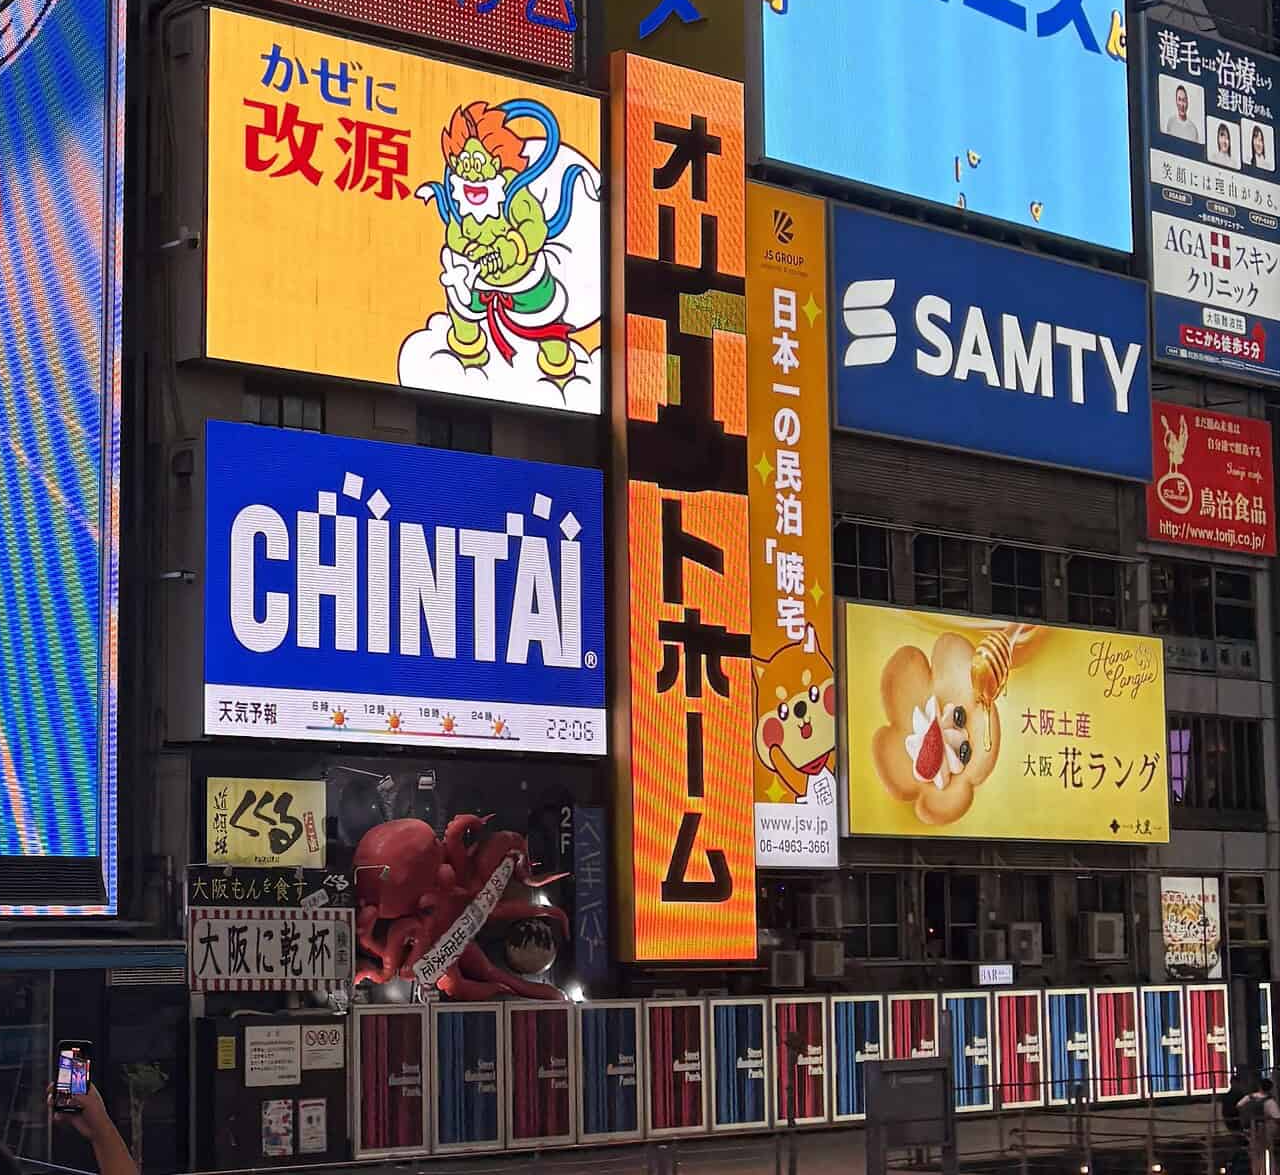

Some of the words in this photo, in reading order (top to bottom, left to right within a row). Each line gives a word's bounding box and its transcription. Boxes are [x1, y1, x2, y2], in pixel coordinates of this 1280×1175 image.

[259, 42, 399, 116] かぜに
[1157, 29, 1273, 95] 薄毛には治療という
[242, 96, 417, 203] 改源
[1162, 161, 1278, 211] 笑顔には理由がある。
[764, 249, 774, 261] JS
[775, 251, 805, 266] GROUP
[1164, 225, 1208, 260] AGA
[1234, 245, 1279, 276] スキン
[1188, 267, 1259, 308] クリニック
[914, 293, 1143, 415] SAMTY
[1185, 328, 1261, 360] ここから徒歩5分
[230, 471, 583, 669] CHINTAI
[218, 699, 278, 726] 天気予報
[1021, 707, 1092, 738] 大阪土産
[1023, 754, 1053, 777] 大阪
[1058, 746, 1161, 792] 花ラング
[559, 806, 572, 854] 2F
[760, 816, 828, 835] www.jsv.jp
[760, 839, 830, 854] 06-4963-3661
[192, 876, 308, 901] 大阪もんを食す
[198, 920, 331, 977] 大阪に乾杯
